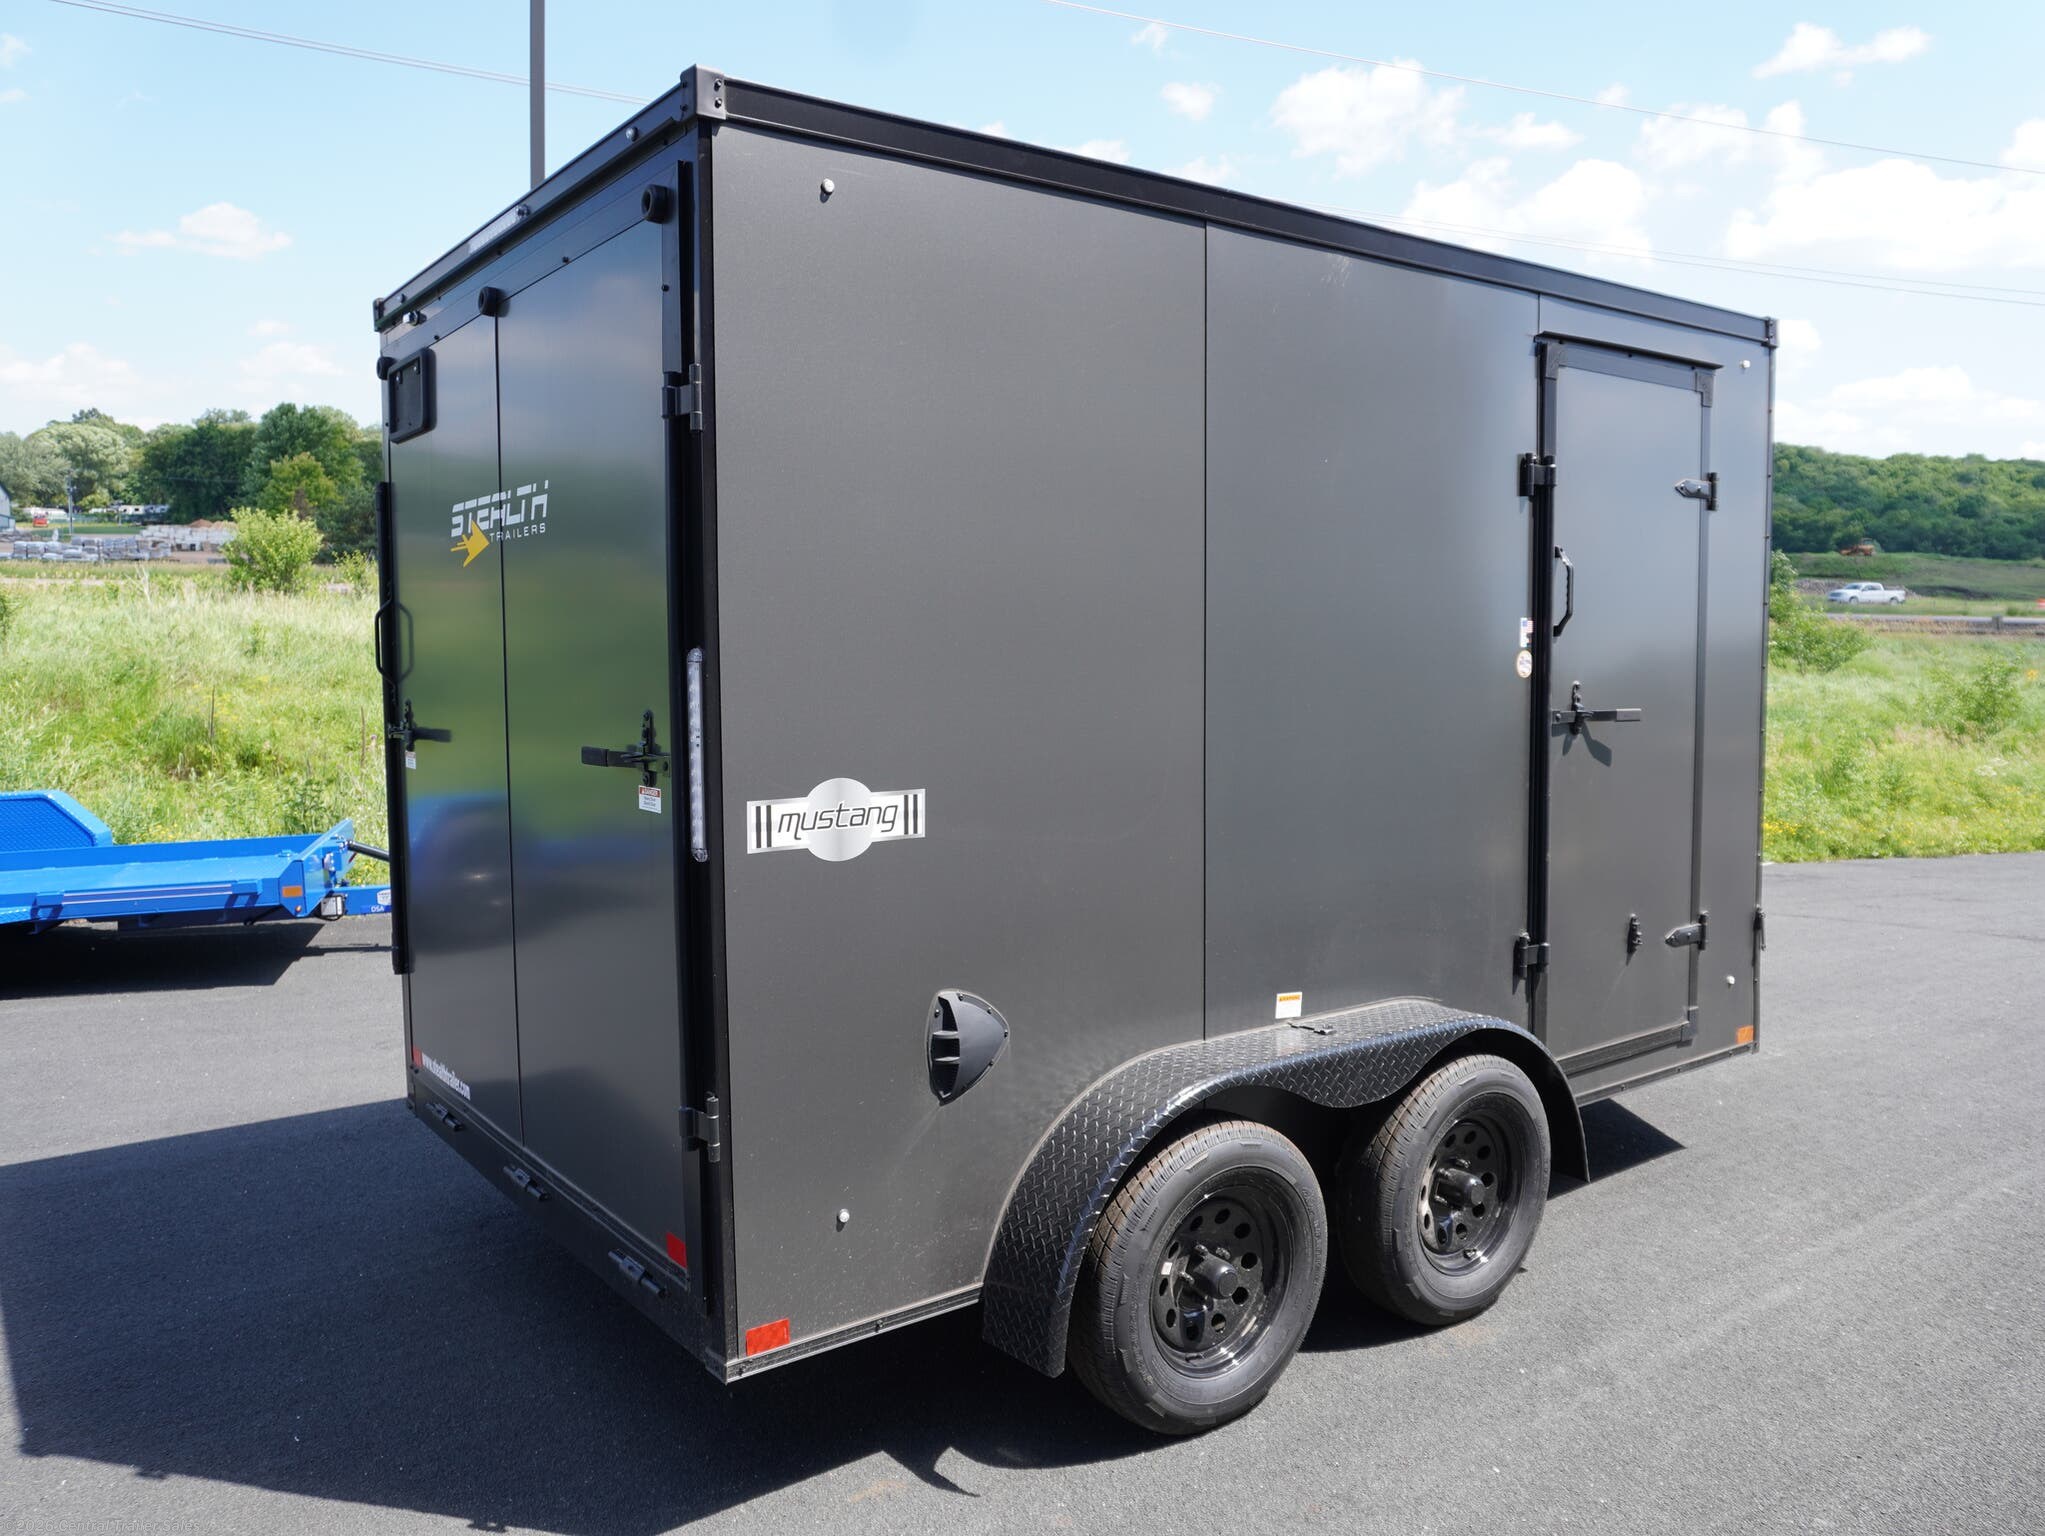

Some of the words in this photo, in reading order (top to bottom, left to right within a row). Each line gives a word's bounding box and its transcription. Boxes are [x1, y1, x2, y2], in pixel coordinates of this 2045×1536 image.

[450, 480, 549, 538] STEALTH
[489, 522, 546, 542] TRAILERS
[777, 802, 899, 841] mustang
